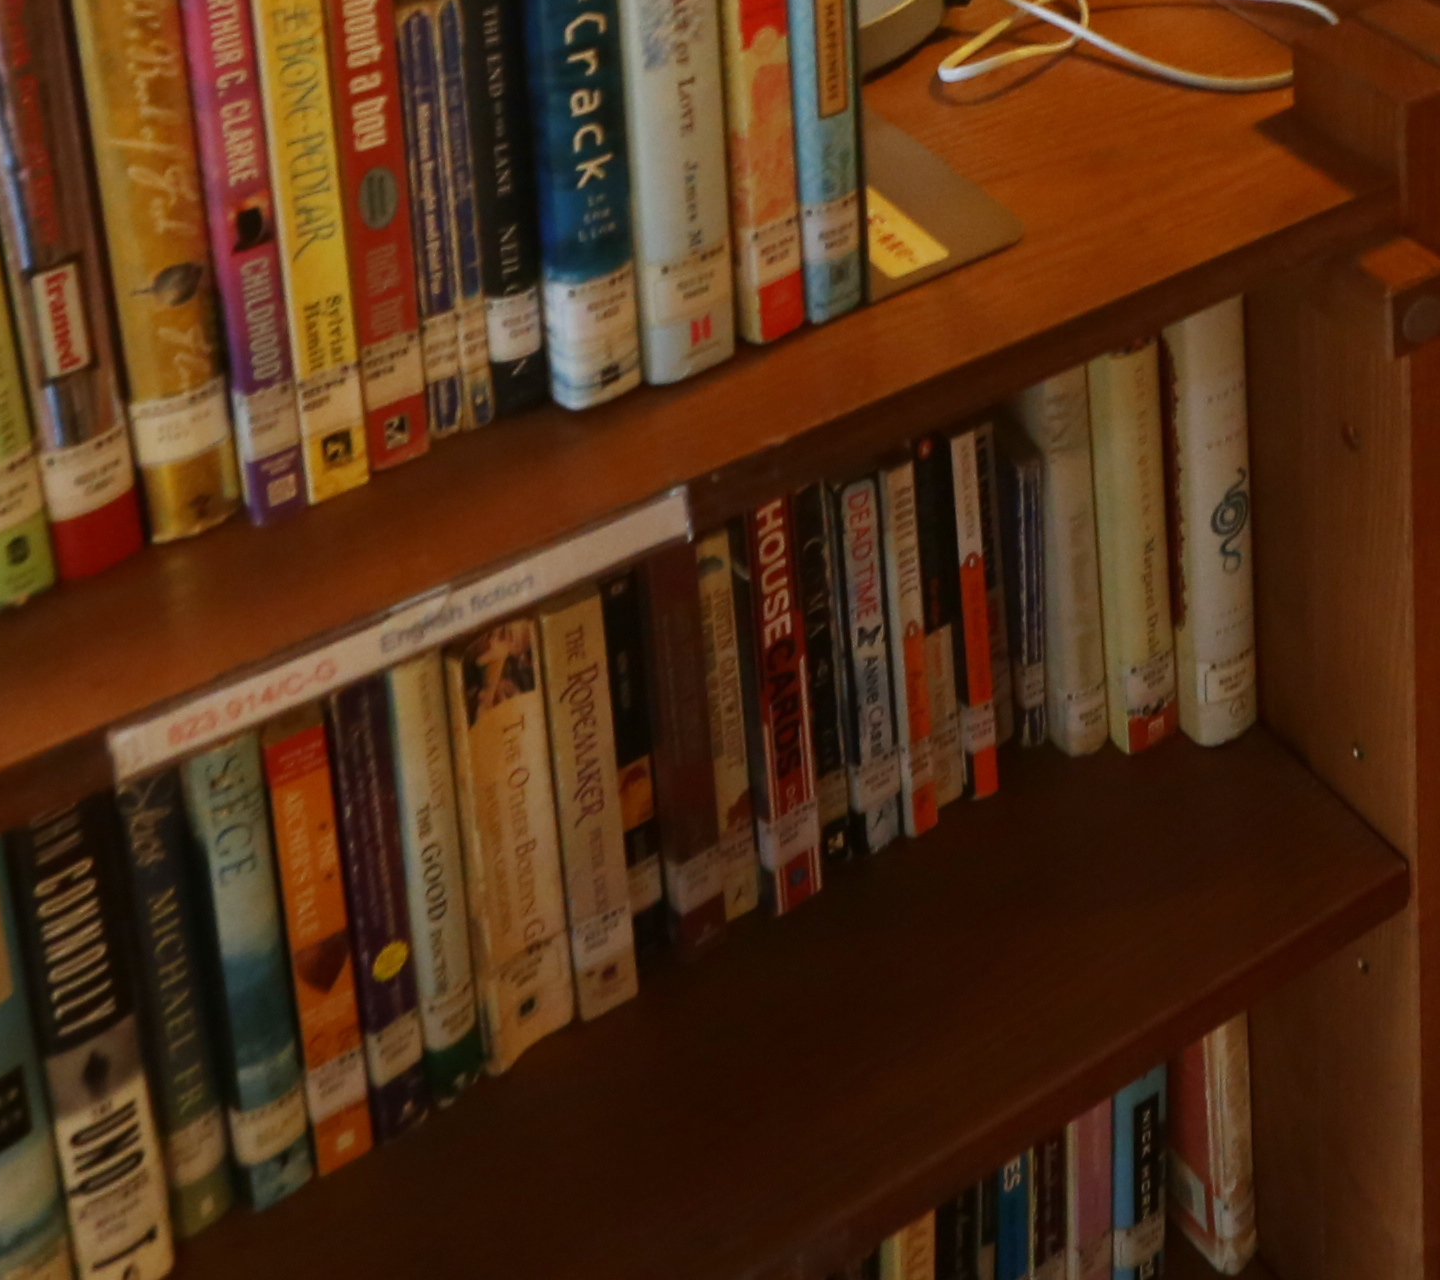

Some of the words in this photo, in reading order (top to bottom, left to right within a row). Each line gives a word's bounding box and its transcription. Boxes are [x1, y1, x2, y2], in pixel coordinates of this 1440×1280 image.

[480, 4, 501, 47] THE
[674, 41, 688, 66] OF
[822, 2, 840, 102] HAPPINESS
[215, 68, 246, 99] C.
[347, 70, 383, 95] a
[484, 50, 504, 99] END
[560, 8, 620, 190] Crack
[677, 76, 697, 138] LOVE
[218, 98, 259, 188] CLARKE
[348, 94, 391, 152] boy
[492, 142, 511, 196] LANE
[684, 159, 702, 224] James
[495, 223, 521, 280] NEIL
[39, 270, 88, 372] framed
[848, 488, 872, 563] DEAD
[752, 502, 791, 647] HOUSE
[853, 565, 878, 620] TIME
[1140, 536, 1157, 611] Margaret
[564, 625, 588, 665] THE
[709, 586, 734, 652] JUSTIN
[500, 714, 528, 765] THE
[766, 641, 806, 778] CARDS
[562, 665, 612, 825] ROPEMAKER
[203, 751, 256, 887] SIEGE
[505, 765, 536, 842] OTHER
[292, 886, 323, 942] TALE
[417, 843, 447, 924] GOOD
[30, 856, 119, 1040] CONNOLLY
[148, 885, 198, 1058] MICHAEL
[1139, 1109, 1151, 1158] NICK
